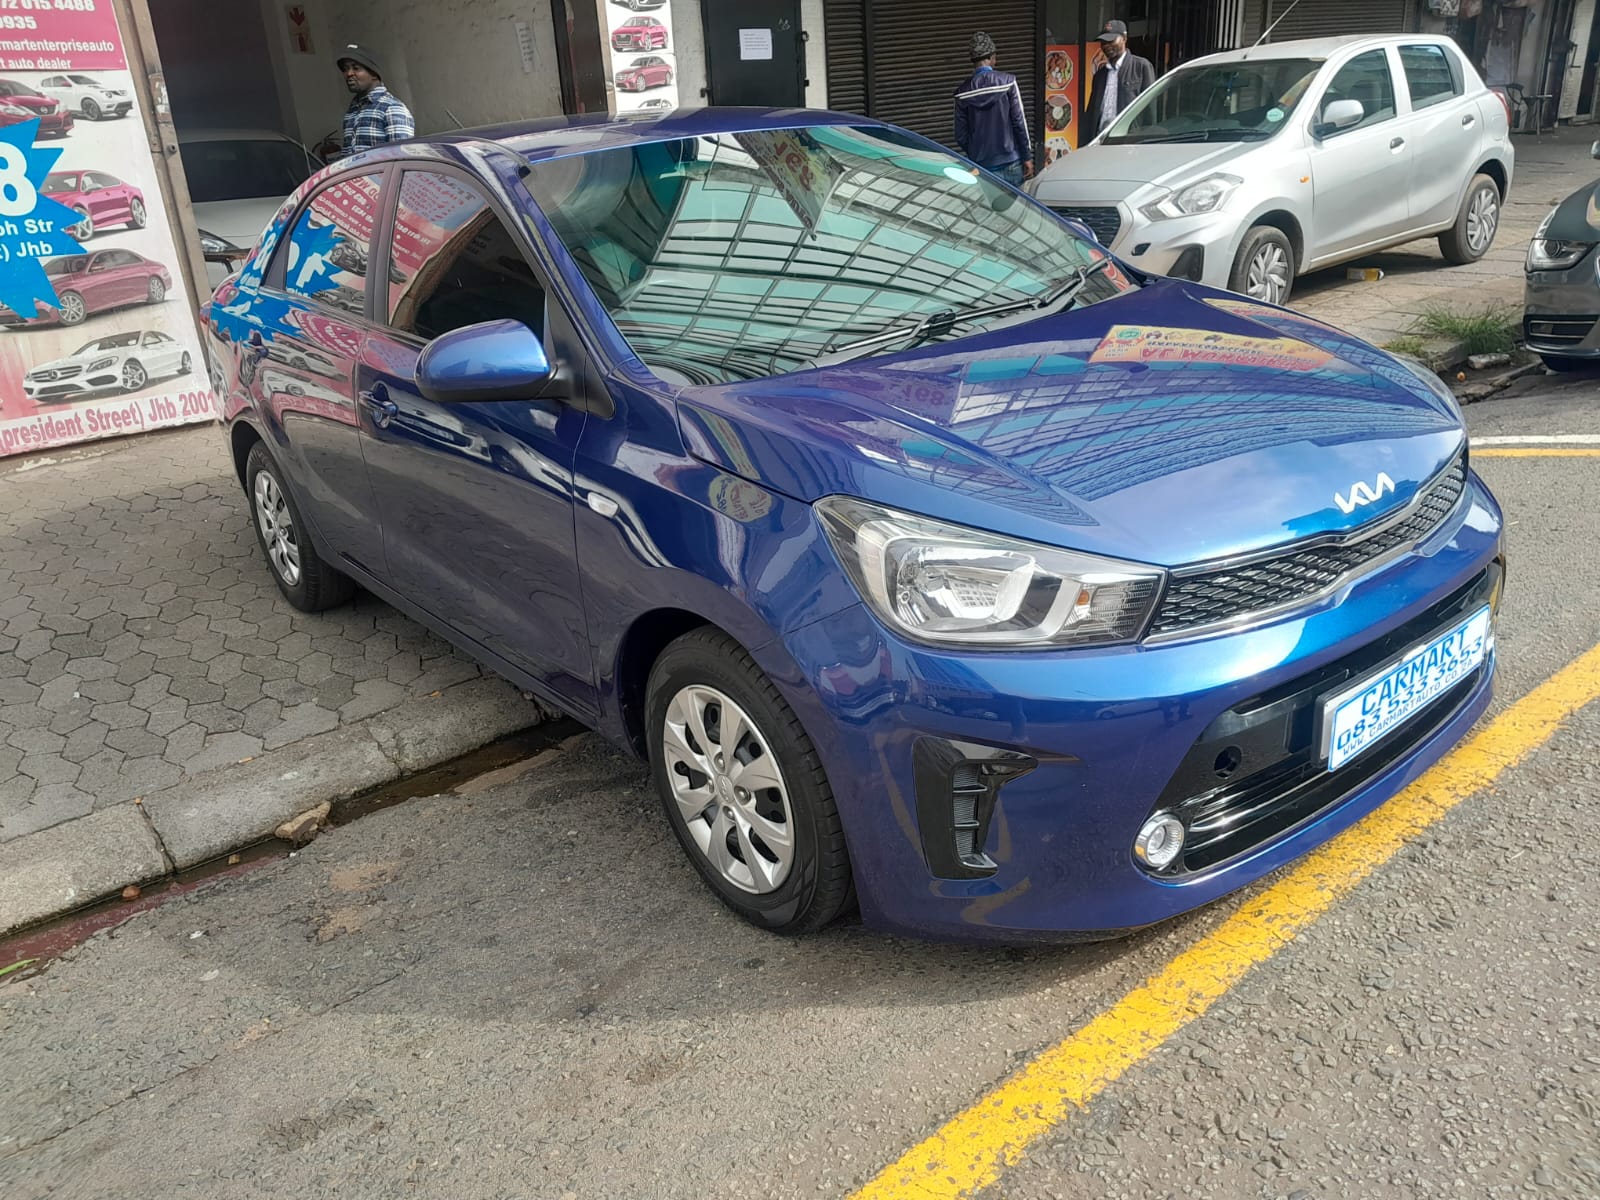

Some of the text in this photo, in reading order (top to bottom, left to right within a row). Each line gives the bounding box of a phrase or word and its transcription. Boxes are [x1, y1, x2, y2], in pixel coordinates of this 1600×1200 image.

[8, 58, 34, 69] auto
[37, 57, 72, 69] dealer
[24, 219, 54, 234] Str
[17, 241, 53, 257] Jhb
[85, 401, 145, 431] Street)
[149, 397, 177, 421] Jhb
[1361, 625, 1469, 716] CARMART
[1337, 636, 1482, 751] 083 533 3653
